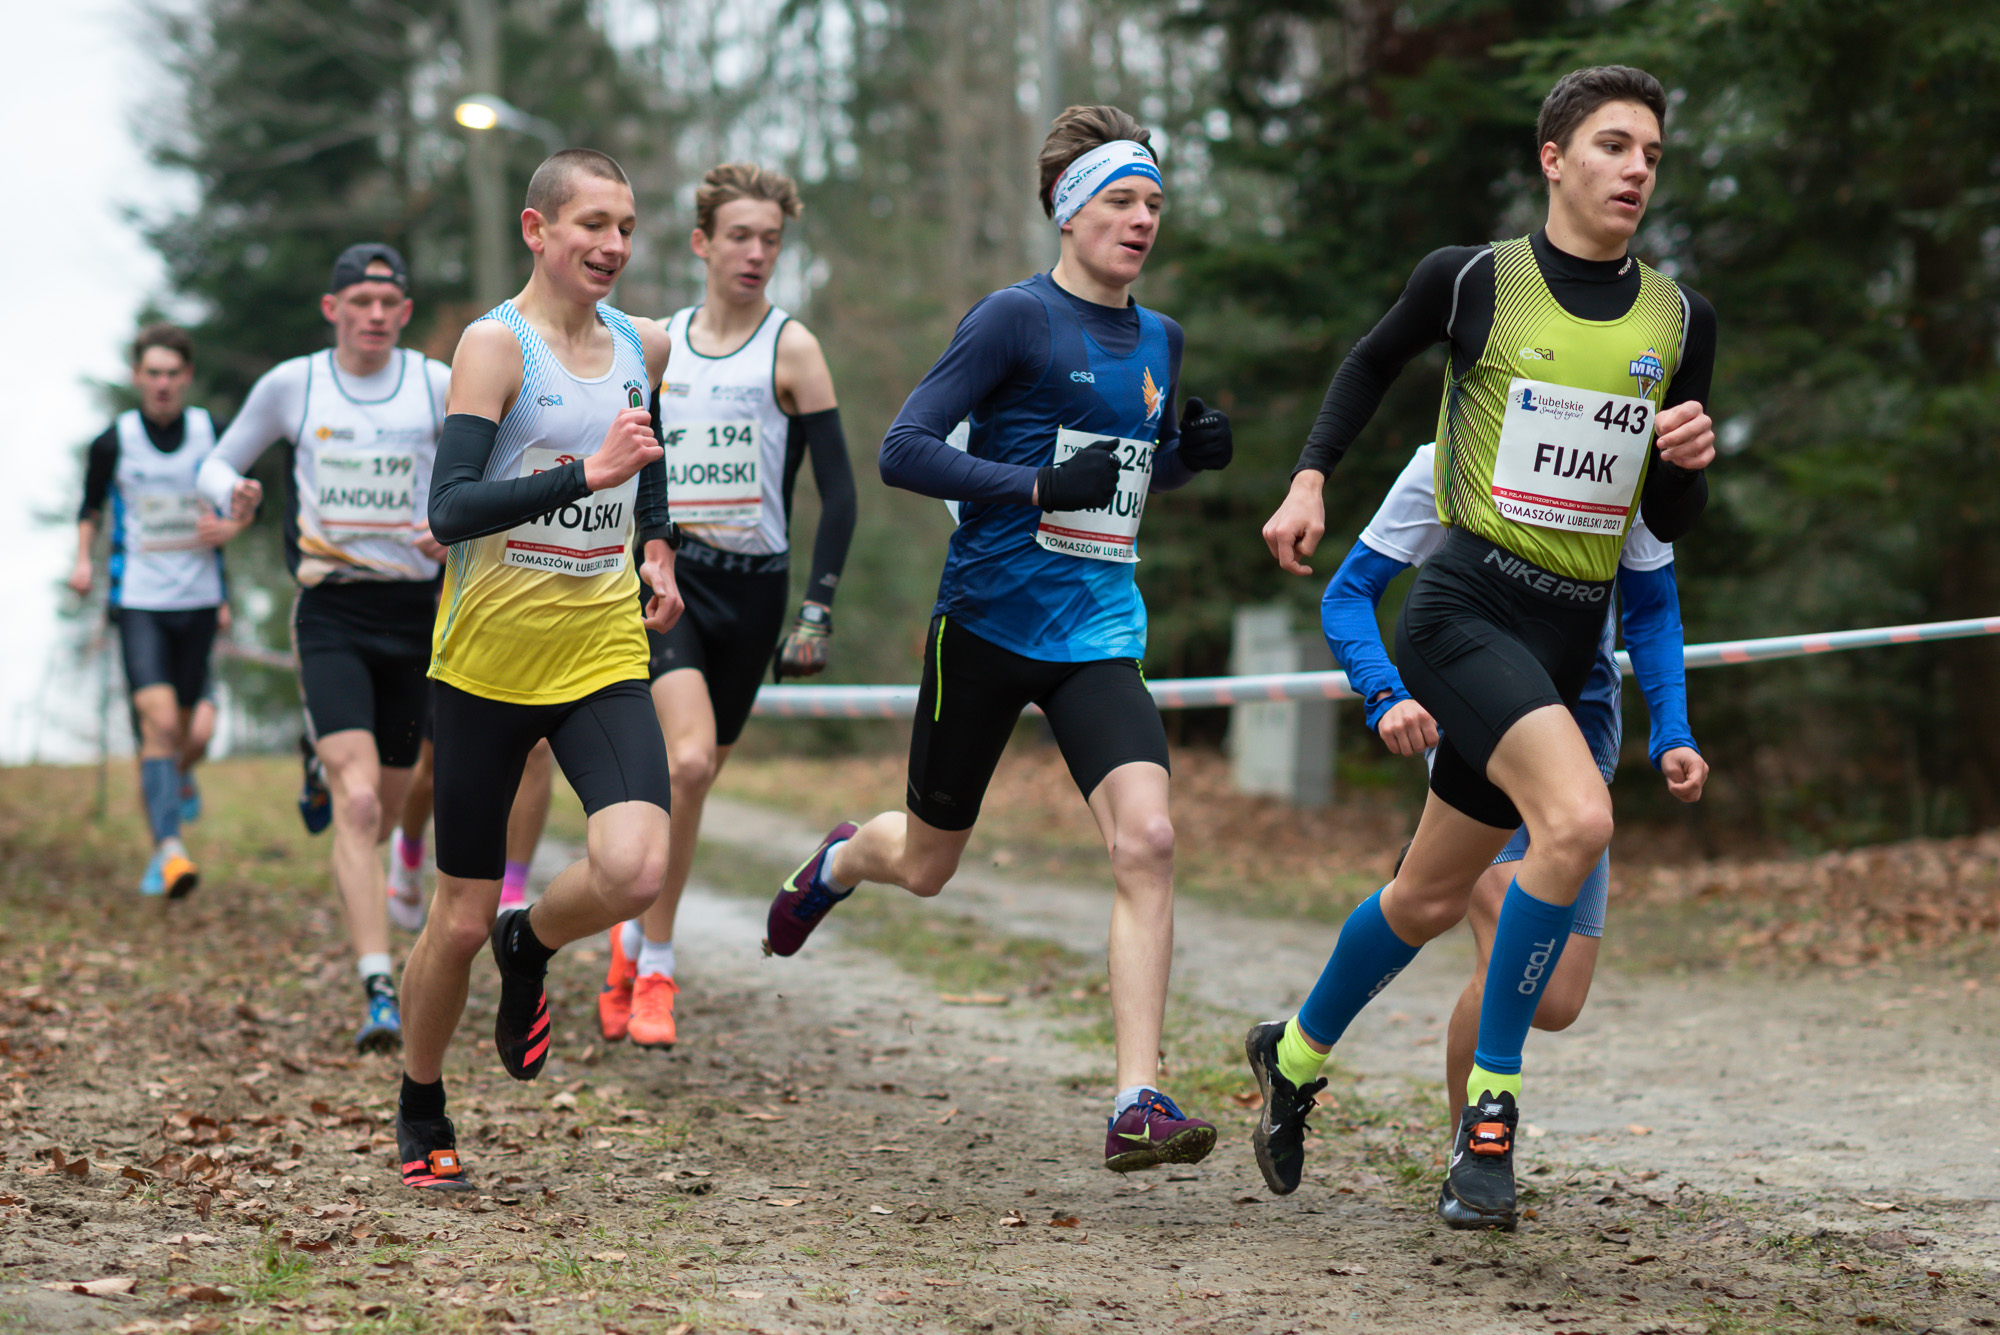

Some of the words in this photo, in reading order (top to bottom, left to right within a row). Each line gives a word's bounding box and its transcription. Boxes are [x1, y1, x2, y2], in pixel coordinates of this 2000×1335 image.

[1519, 347, 1555, 361] esa
[1069, 370, 1096, 384] esa
[1631, 362, 1664, 381] MKS
[537, 394, 564, 406] esa
[1539, 394, 1584, 411] lubelskie
[1594, 401, 1649, 434] 443
[706, 425, 753, 448] 194
[372, 457, 412, 477] 199
[1533, 443, 1618, 484] FIJAK
[319, 487, 412, 510] JANDUŁA
[1499, 502, 1565, 524] TOMASZÓW
[1567, 515, 1602, 529] LUBELSKI
[1603, 519, 1621, 531] 2021
[1045, 536, 1101, 555] TOMASZÓW
[511, 552, 573, 571] TOMASZÓW
[576, 560, 602, 573] LUBELSKI
[603, 558, 618, 569] 2021
[1483, 549, 1557, 594] NIKE
[1552, 581, 1606, 603] PRO
